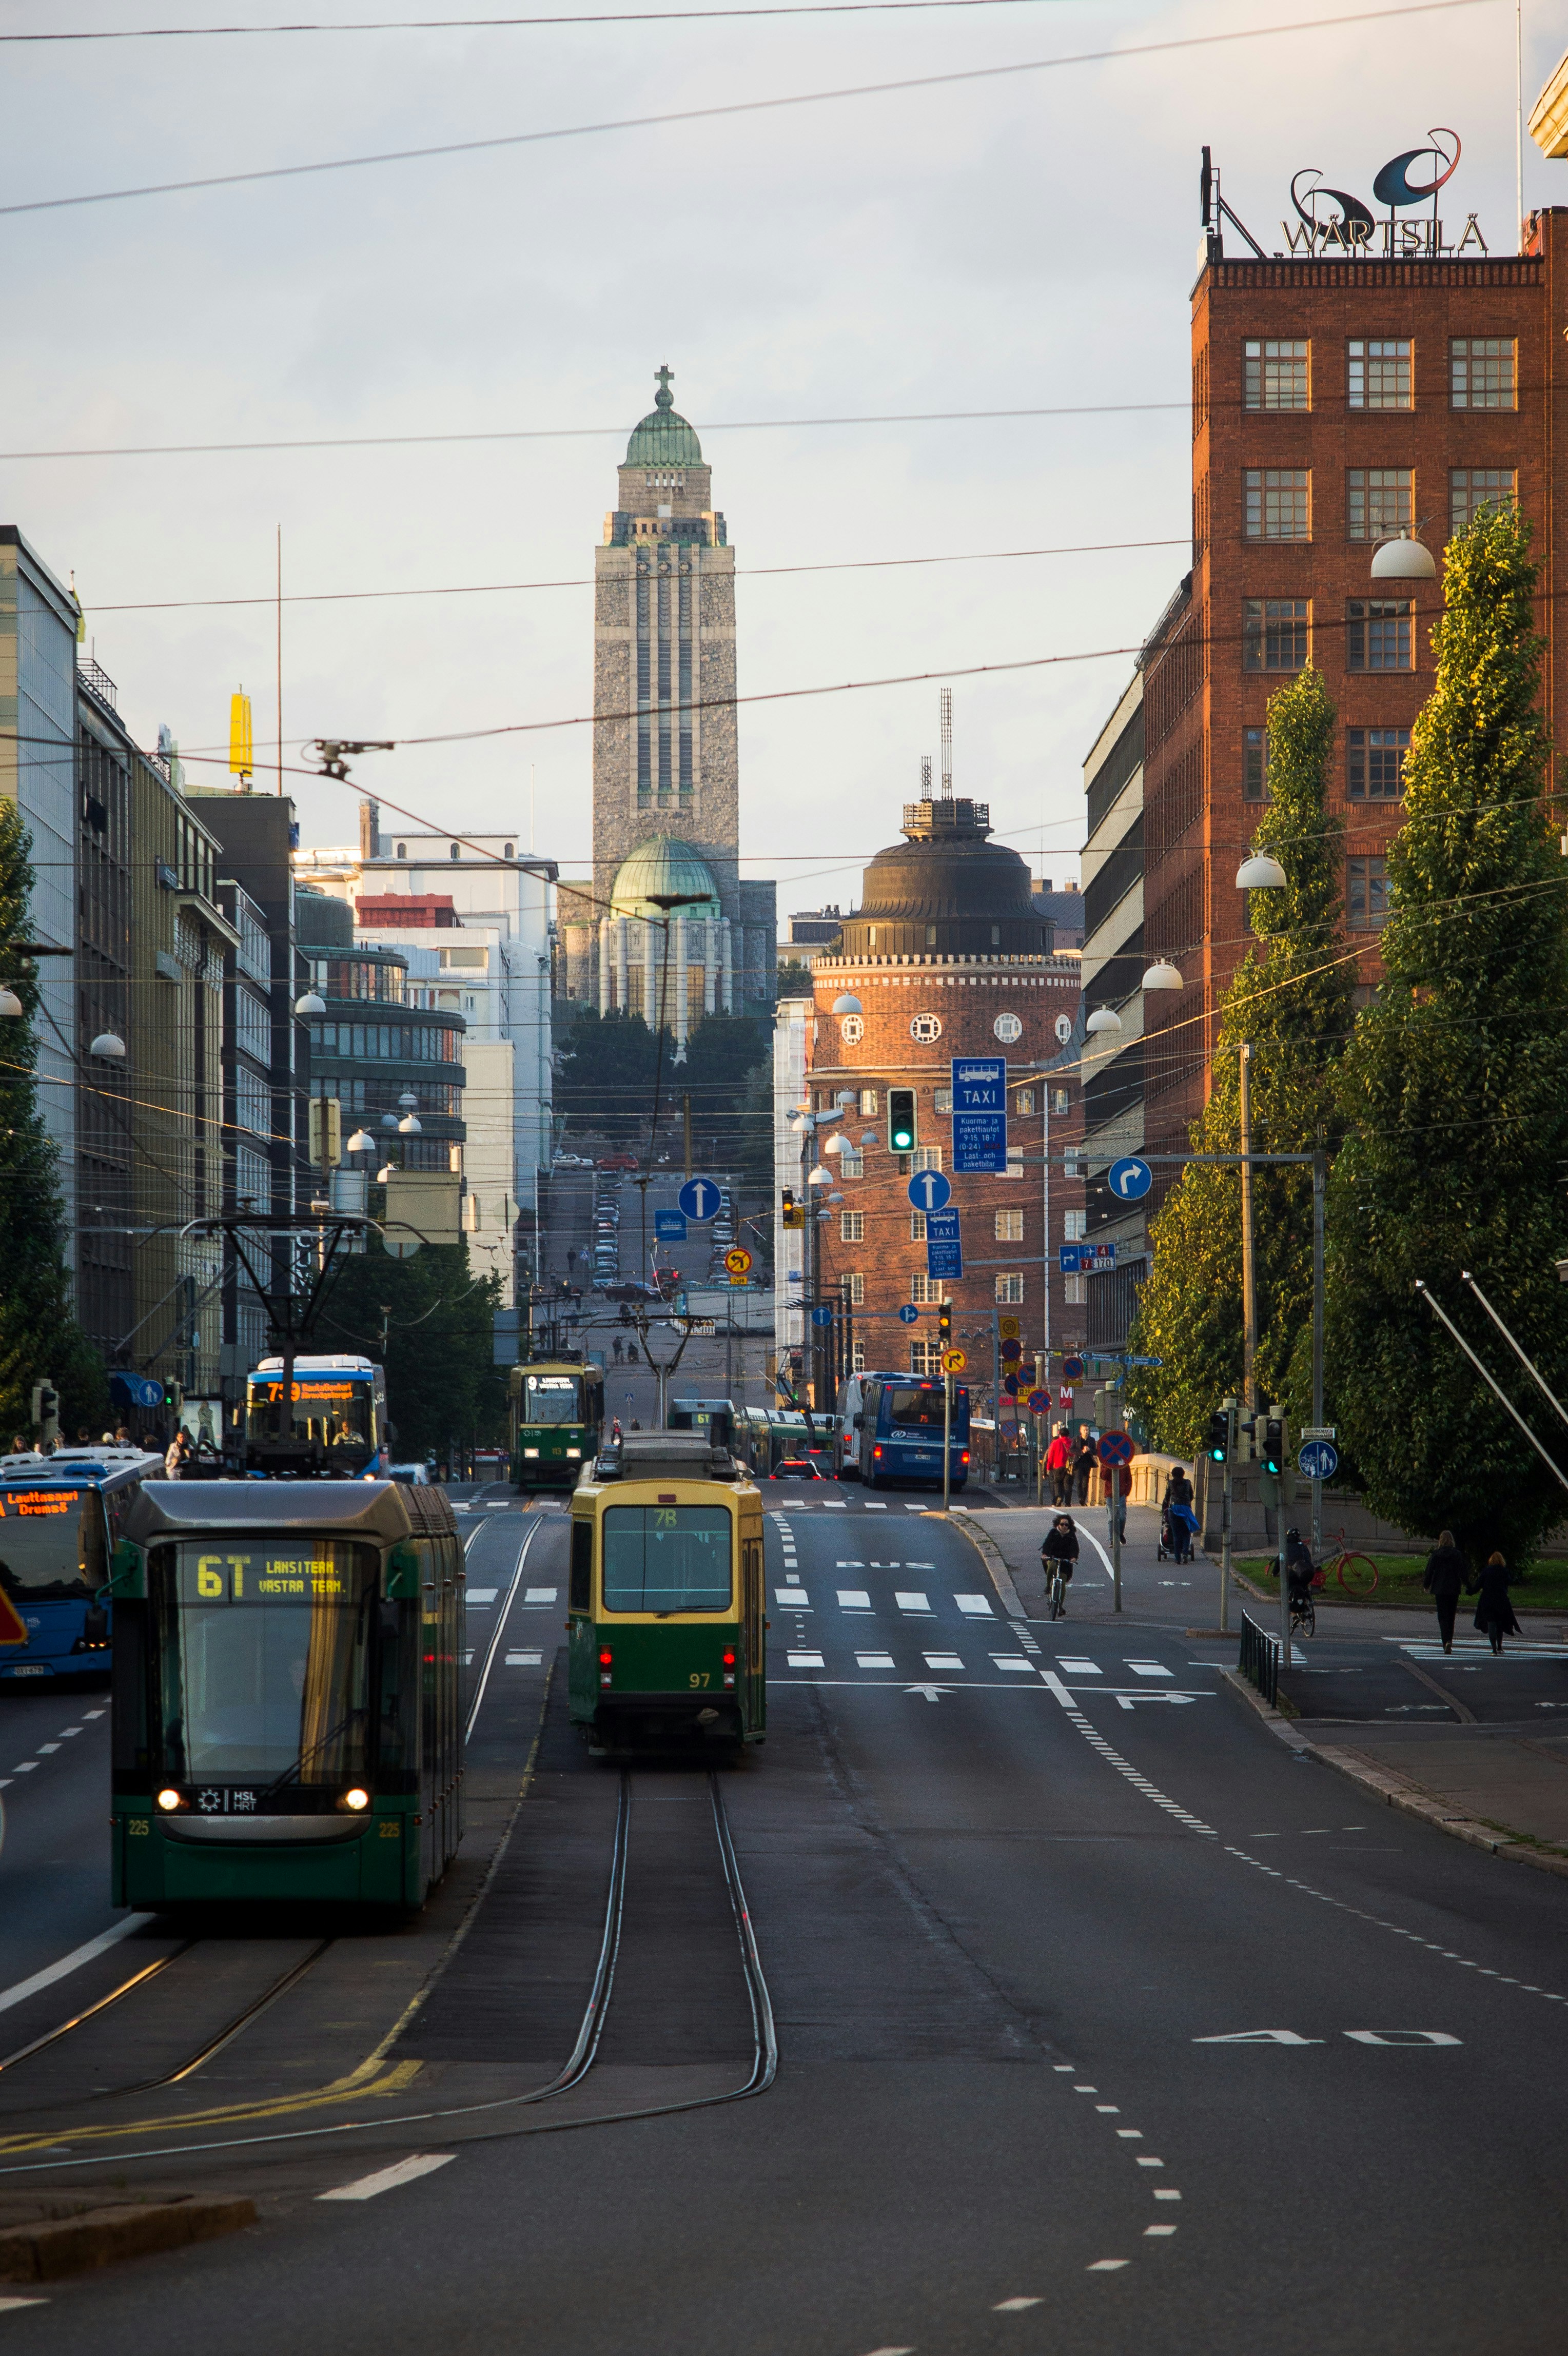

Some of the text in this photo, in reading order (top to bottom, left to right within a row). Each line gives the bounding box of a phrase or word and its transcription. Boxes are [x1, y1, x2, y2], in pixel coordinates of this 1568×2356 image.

[1280, 213, 1489, 251] WÄRTSILÄ
[963, 1090, 995, 1104] TAXI
[959, 1126, 999, 1134] pakettiautot
[964, 1160, 995, 1169] paketbilar
[933, 1226, 954, 1236] TAXI
[1101, 1247, 1106, 1255] 4
[1084, 1259, 1111, 1268] 7 170
[528, 1376, 537, 1390] 9
[1061, 1386, 1073, 1399] M
[920, 1415, 928, 1423] 75
[7, 1490, 79, 1504] Lauttasaari
[18, 1501, 68, 1515] Drumsö
[198, 1555, 251, 1597] 6T
[310, 1580, 346, 1593] TERM.
[689, 1673, 710, 1688] 97
[234, 1792, 257, 1801] HSL
[234, 1801, 257, 1811] HRT
[129, 1820, 149, 1836] 225
[379, 1822, 399, 1838] 225
